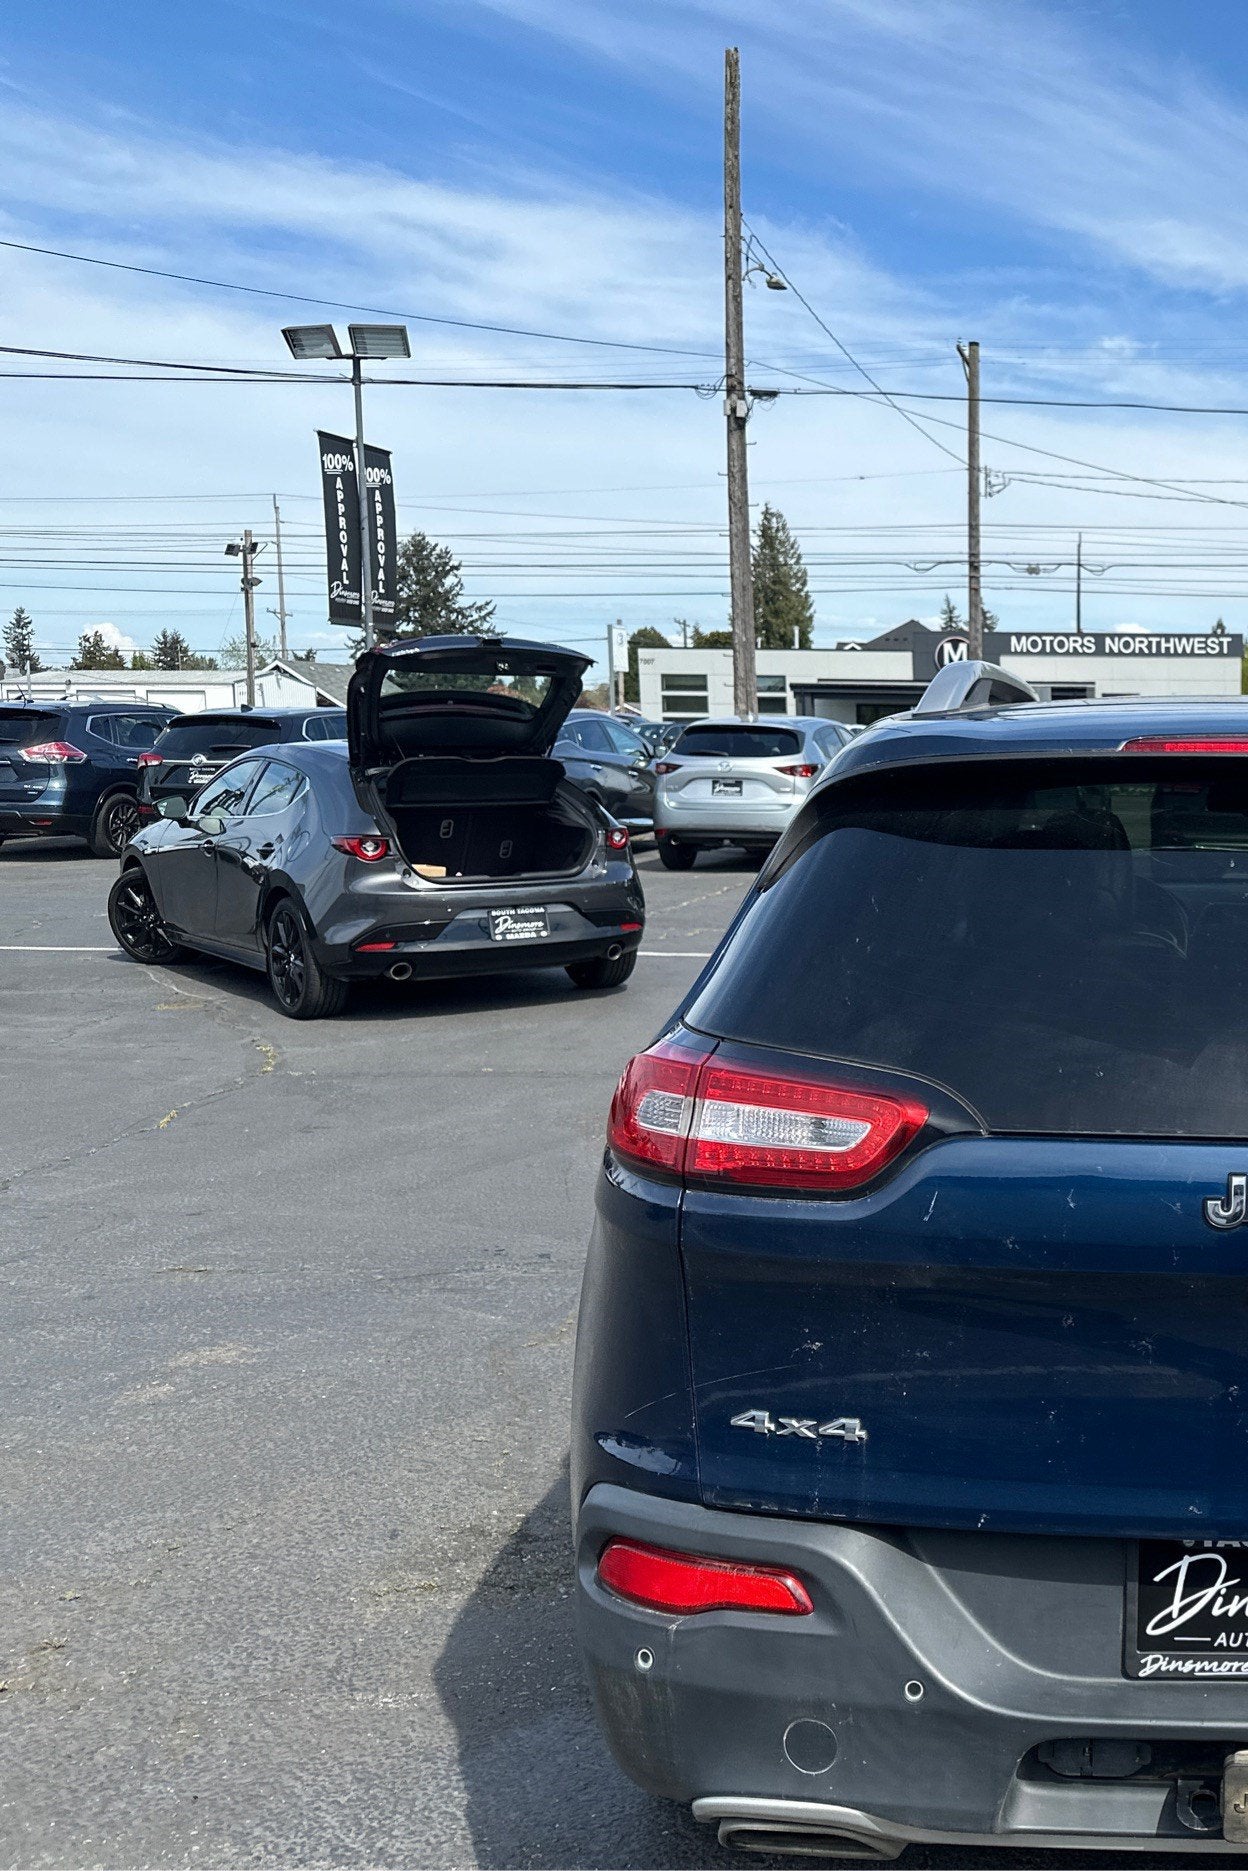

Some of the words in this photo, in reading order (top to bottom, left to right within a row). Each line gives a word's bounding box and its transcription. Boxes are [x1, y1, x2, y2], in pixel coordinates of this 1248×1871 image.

[322, 453, 354, 471] 100%
[364, 467, 391, 485] 00%
[335, 476, 349, 585] APPROVAL
[374, 489, 386, 594] APPROVAL
[1010, 635, 1096, 654] MOTORS
[1104, 636, 1232, 655] NORTHWEST
[491, 909, 516, 917] SOUTH
[517, 906, 546, 915] TACOMA
[506, 931, 537, 940] MAZDA
[730, 1409, 868, 1441] 4x4
